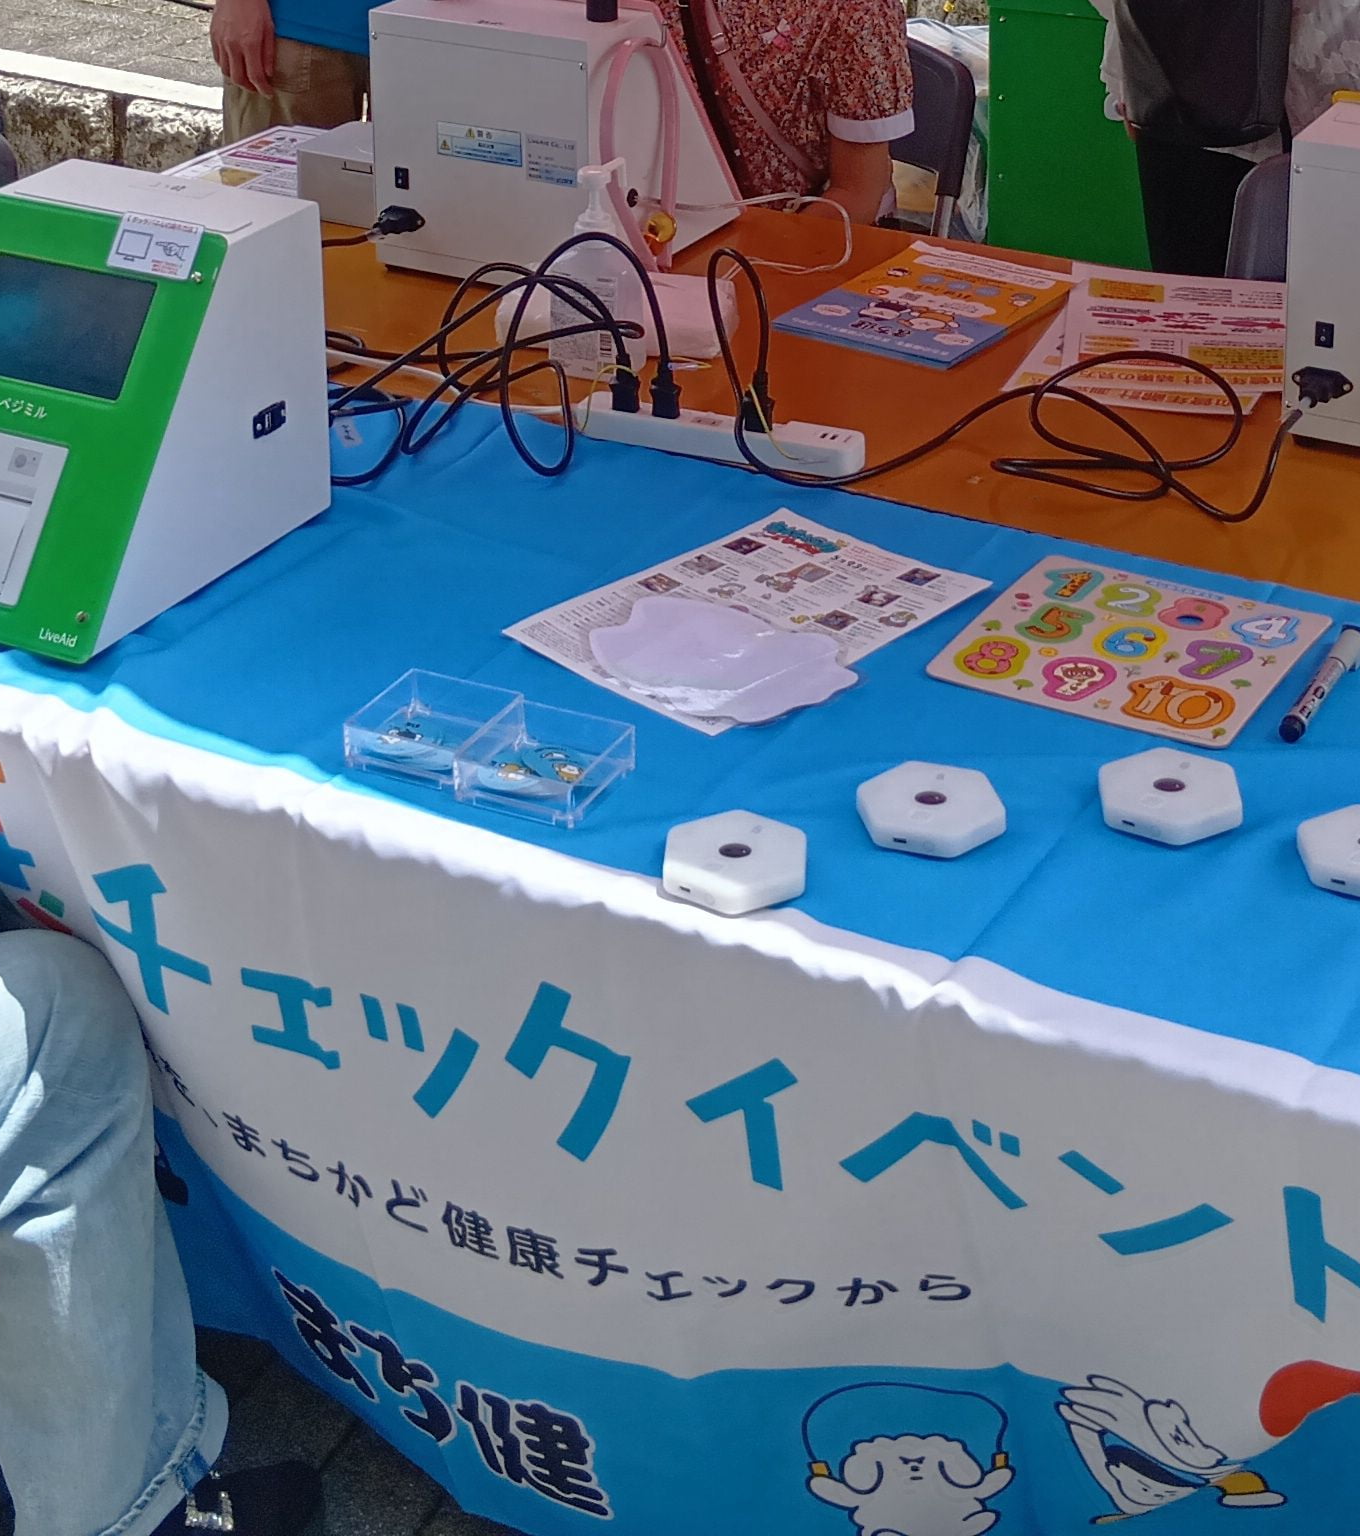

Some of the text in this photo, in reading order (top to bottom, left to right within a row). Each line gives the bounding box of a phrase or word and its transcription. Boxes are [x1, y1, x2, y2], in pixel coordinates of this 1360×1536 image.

[1107, 587, 1152, 613] 2
[1024, 606, 1084, 638] 5
[38, 627, 78, 648] LiveAid
[1104, 628, 1157, 657] 6
[965, 640, 1019, 674] 8
[273, 1269, 614, 1520] まち健
